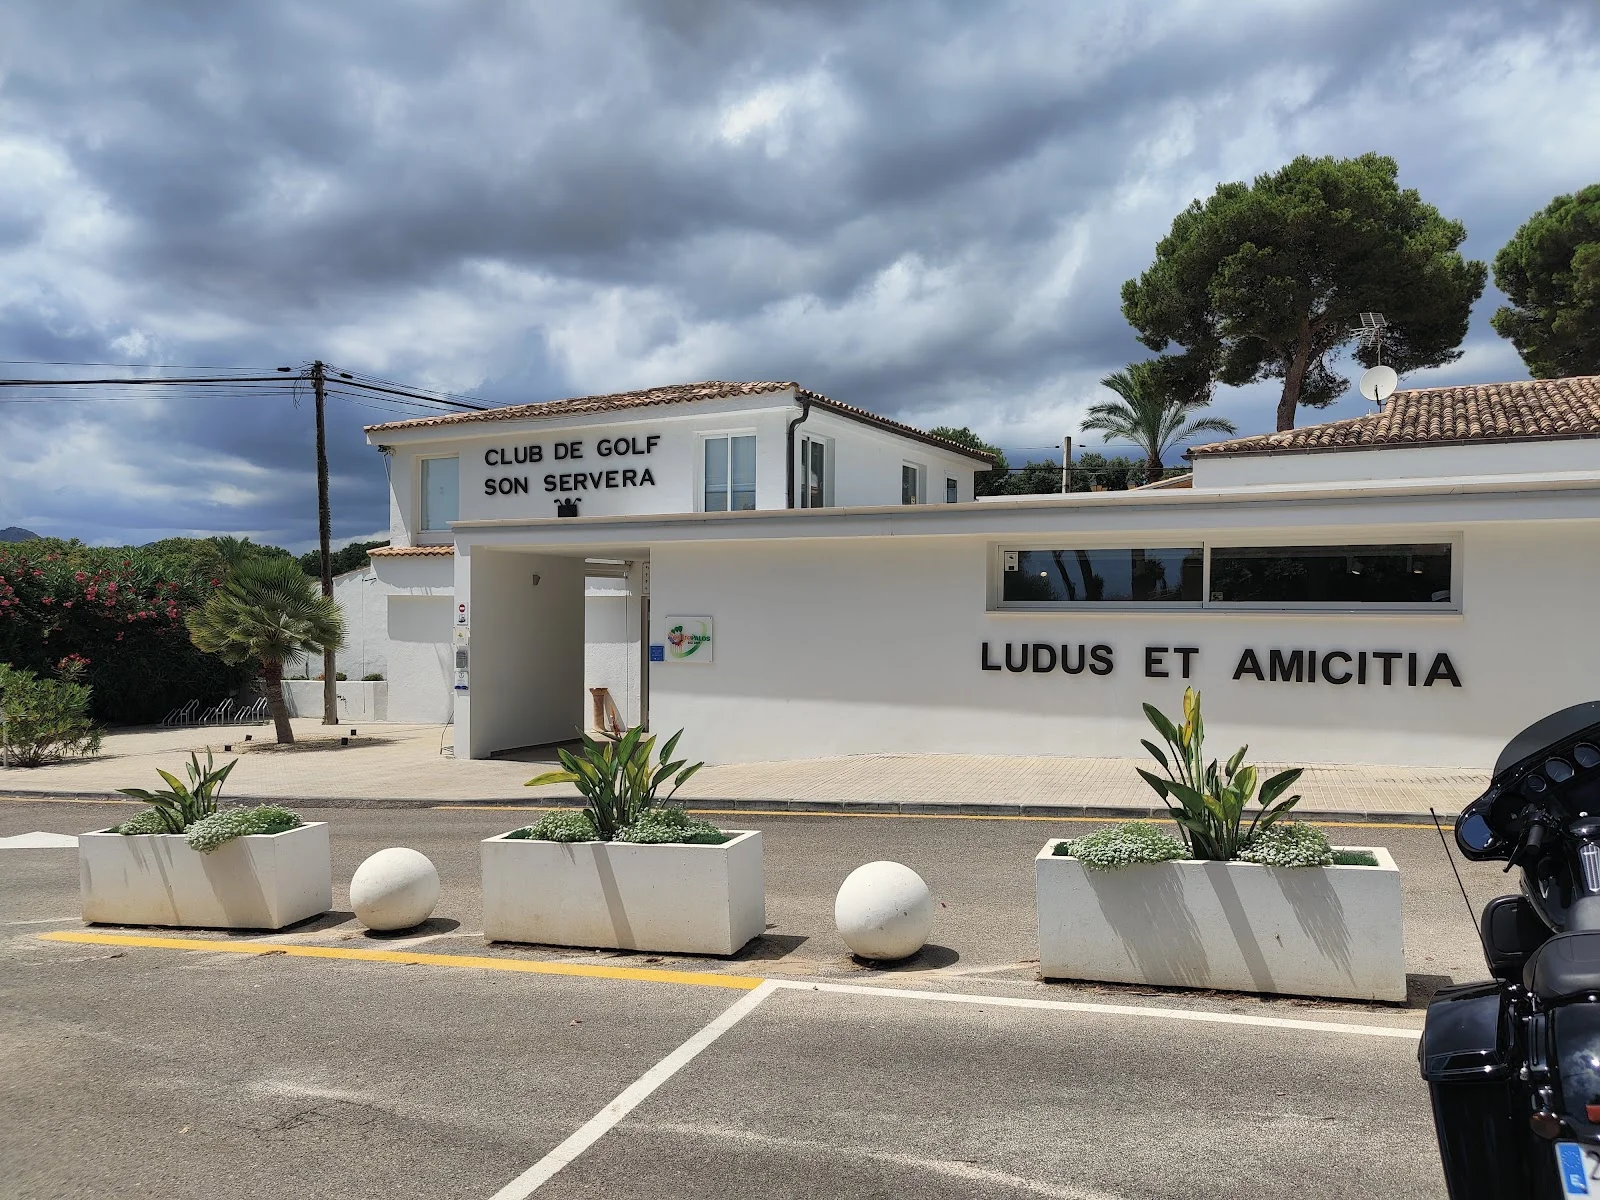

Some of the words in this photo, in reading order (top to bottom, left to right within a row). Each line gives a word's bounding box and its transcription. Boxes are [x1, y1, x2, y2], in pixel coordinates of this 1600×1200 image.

[484, 445, 544, 467] CLUB
[554, 441, 584, 461] DE
[596, 435, 661, 458] GOLF
[484, 476, 529, 496] SON
[543, 468, 656, 493] SERVERA
[981, 642, 1114, 676] LUDUS
[1144, 647, 1200, 679] ET
[1232, 648, 1463, 688] AMICITIA
[1569, 1173, 1582, 1187] E
